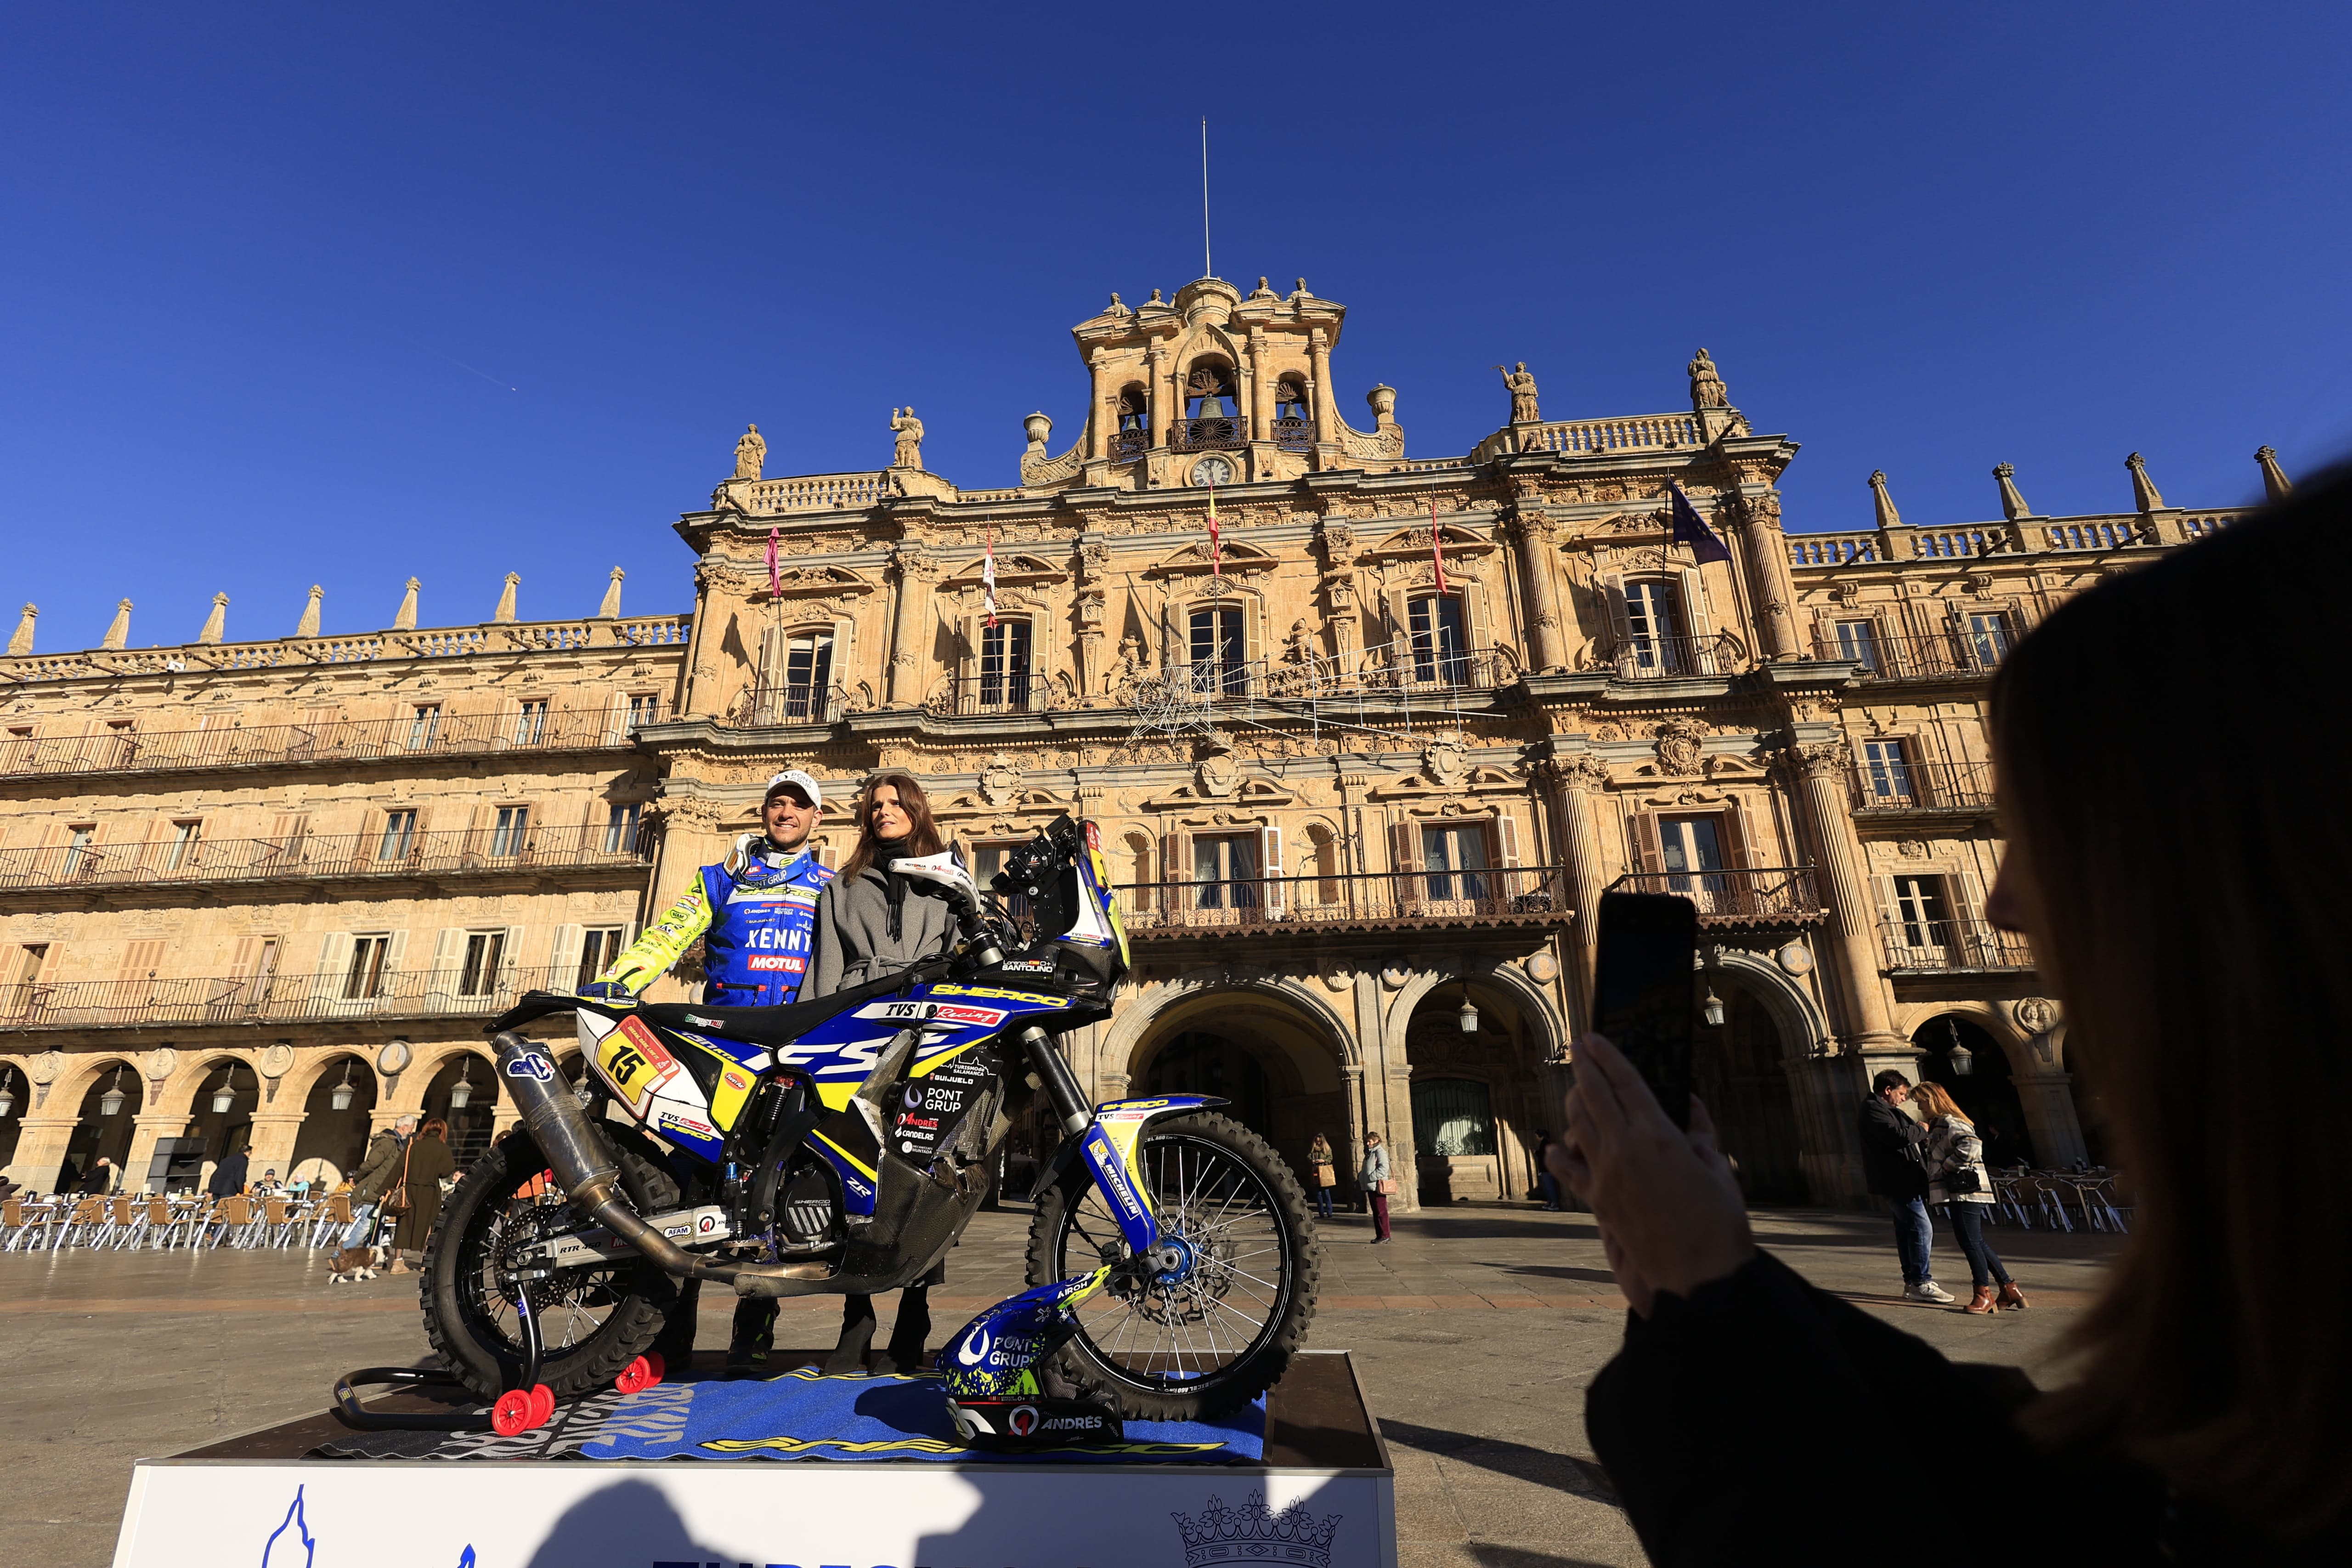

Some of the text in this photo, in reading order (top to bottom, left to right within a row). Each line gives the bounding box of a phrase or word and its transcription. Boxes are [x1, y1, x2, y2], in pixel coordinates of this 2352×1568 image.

[790, 777, 811, 788] GRUP
[791, 772, 813, 784] PONT
[745, 878, 766, 887] PONT
[768, 870, 787, 884] GRUP
[678, 915, 705, 946] PONT GRUP
[745, 928, 811, 952] KENNY
[751, 957, 802, 971] MOTUL
[1002, 964, 1053, 973] SANTOLINO
[929, 984, 1069, 1007] SHERCO
[885, 1004, 999, 1022] TVS Racing
[627, 1025, 640, 1040] DREAM.
[639, 1036, 649, 1050] DARE.
[647, 1047, 656, 1058] LIVE
[607, 1045, 646, 1086] 15
[725, 1074, 738, 1084] Twin
[934, 1075, 974, 1085] GUIJUELO
[927, 1087, 963, 1101] PONT
[925, 1099, 961, 1113] GRUP
[1102, 1099, 1169, 1111] SHERCO
[661, 1111, 680, 1122] TVS
[661, 1121, 713, 1142] SHERCO
[902, 1130, 934, 1141] CANDELAS
[1105, 1164, 1139, 1214] MICHELIN
[667, 1227, 688, 1235] AFAM
[560, 1241, 602, 1254] RTR 450
[1057, 1281, 1088, 1299] AIROH
[992, 1336, 1033, 1353] PONT
[989, 1351, 1030, 1368] GRUP
[1040, 1415, 1102, 1430] ANDRÉS
[1108, 1422, 1119, 1438] AIROH
